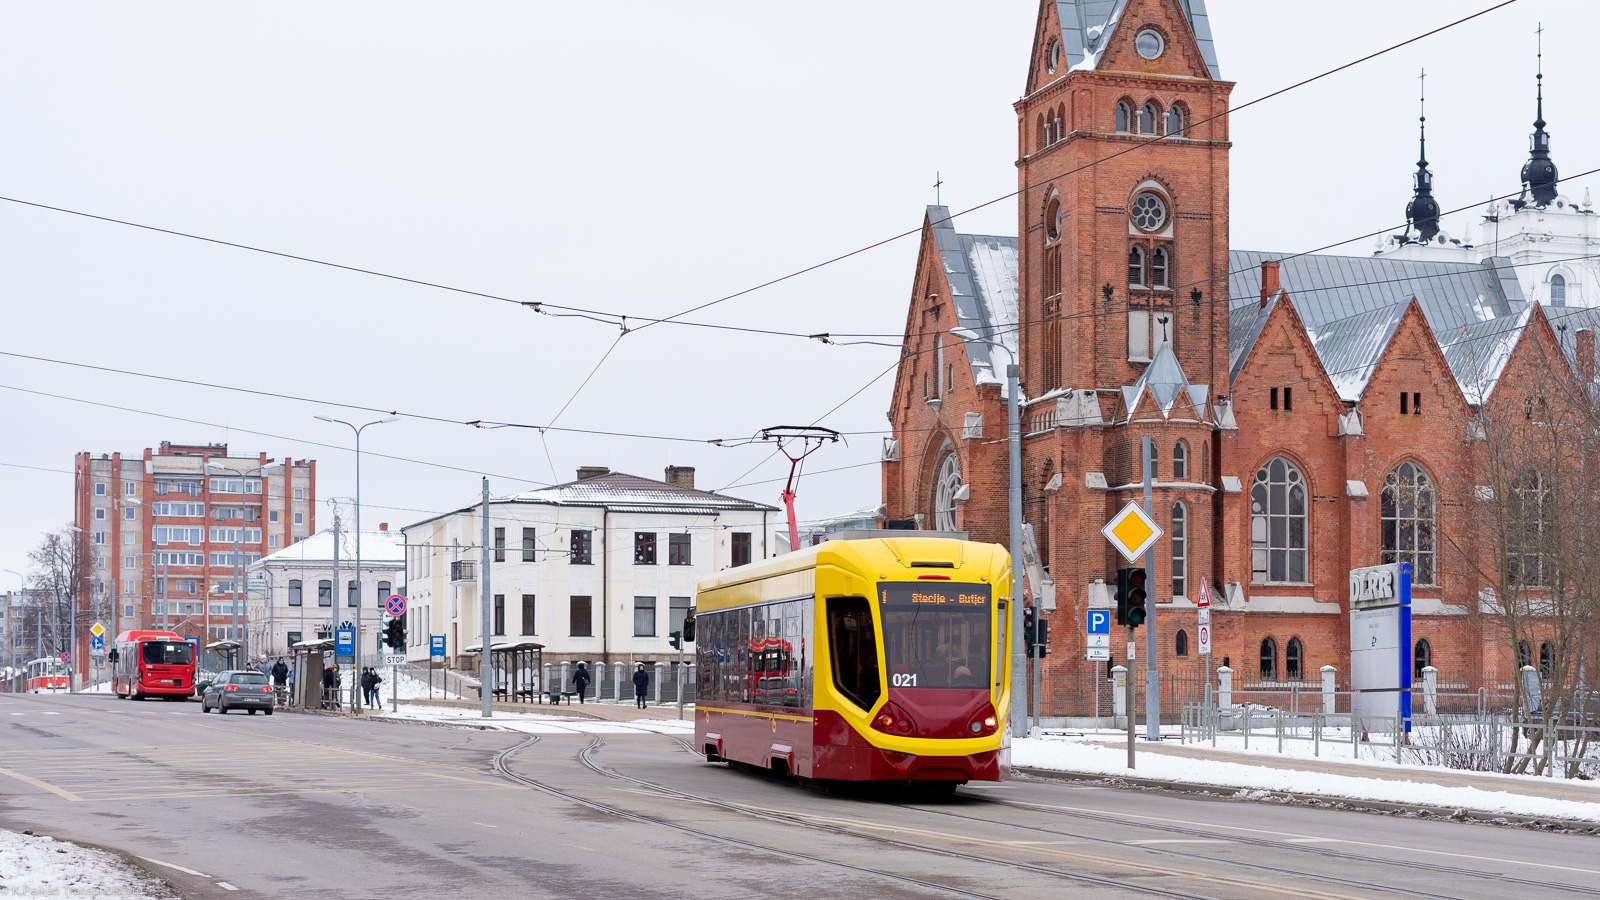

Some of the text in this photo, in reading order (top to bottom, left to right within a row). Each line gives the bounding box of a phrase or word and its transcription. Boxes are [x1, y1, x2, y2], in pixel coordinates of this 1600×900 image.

[1350, 571, 1393, 602] DLRR
[1092, 613, 1105, 631] P
[386, 656, 405, 664] STOP
[892, 673, 917, 687] 021
